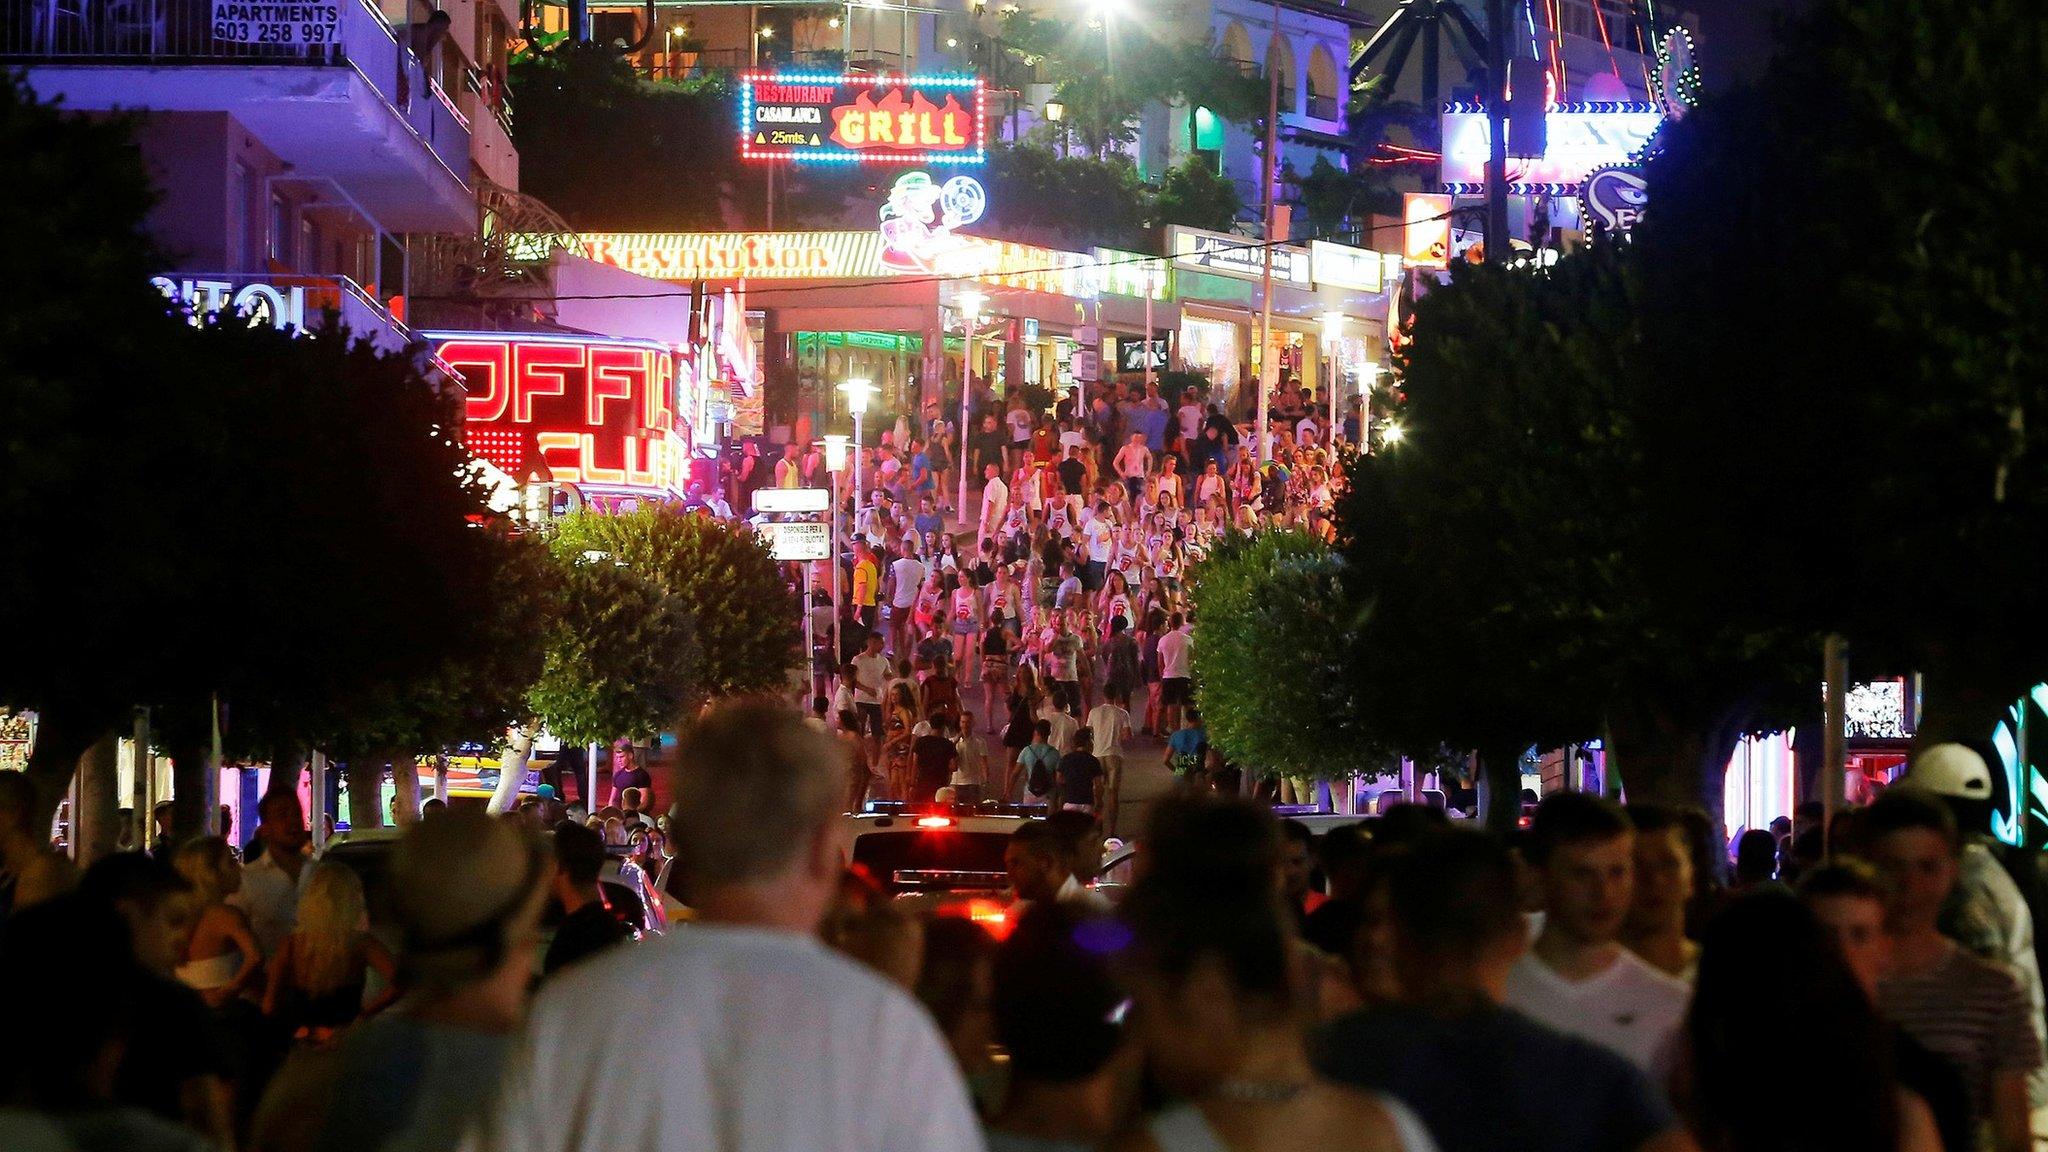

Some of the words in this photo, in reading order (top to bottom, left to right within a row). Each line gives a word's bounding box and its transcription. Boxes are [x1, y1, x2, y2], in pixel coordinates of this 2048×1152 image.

[215, 5, 337, 22] APARTMENTS
[215, 22, 249, 40] 603
[258, 24, 292, 42] 258
[301, 23, 336, 42] 997
[755, 85, 834, 103] RESTAURANT
[755, 106, 822, 123] CASABLANCA
[839, 109, 965, 145] GRILL
